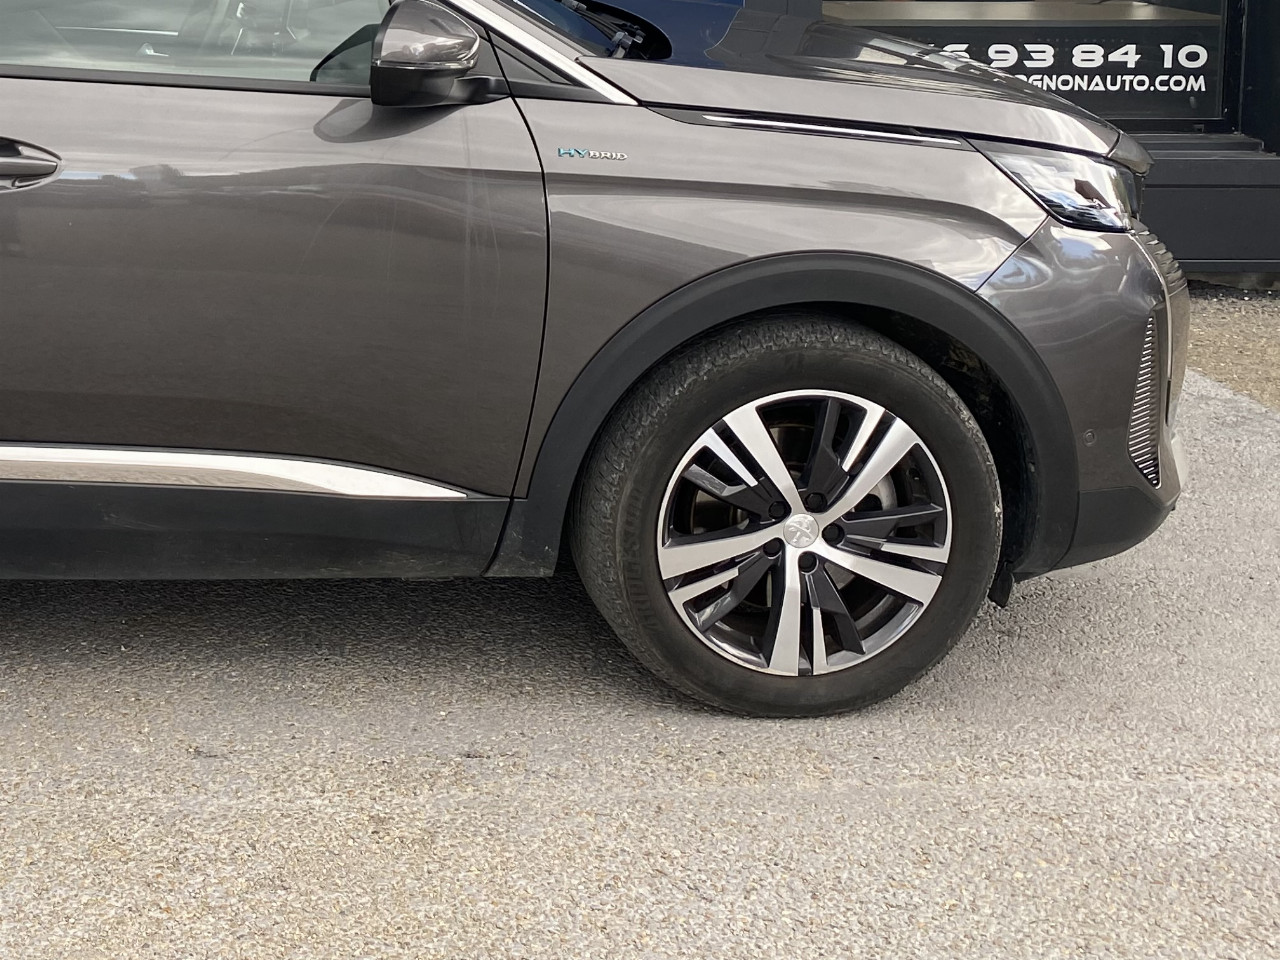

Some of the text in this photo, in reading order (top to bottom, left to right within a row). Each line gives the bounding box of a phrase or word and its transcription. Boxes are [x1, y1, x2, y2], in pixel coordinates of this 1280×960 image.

[1071, 44, 1142, 69] 84
[1160, 44, 1208, 69] 10
[557, 147, 628, 161] HYBRID
